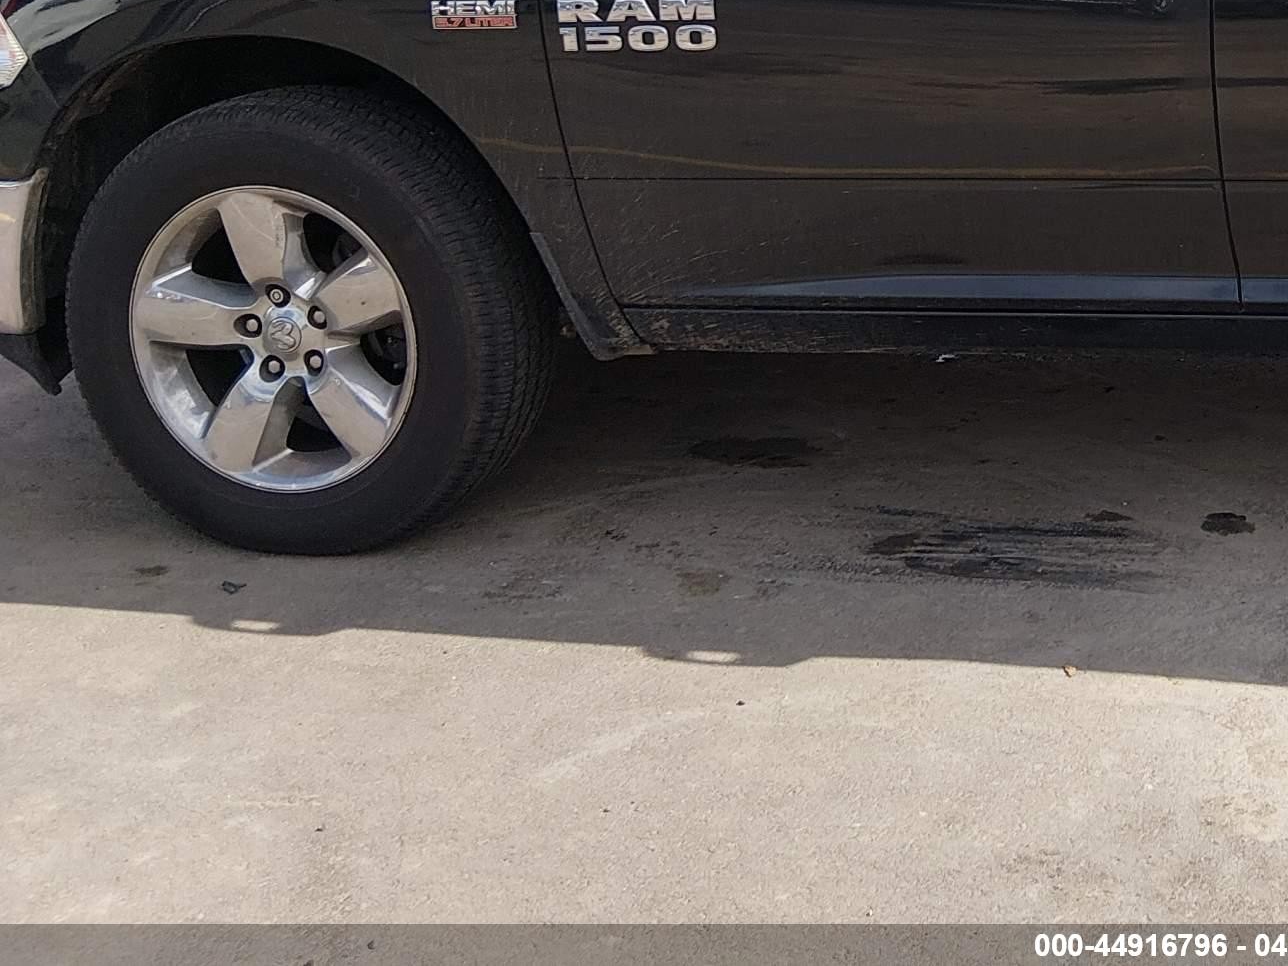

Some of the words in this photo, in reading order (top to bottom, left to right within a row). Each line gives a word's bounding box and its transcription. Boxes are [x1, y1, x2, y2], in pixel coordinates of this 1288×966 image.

[431, 0, 516, 15] HEMI
[435, 17, 463, 27] 5.7
[559, 24, 717, 52] 1500
